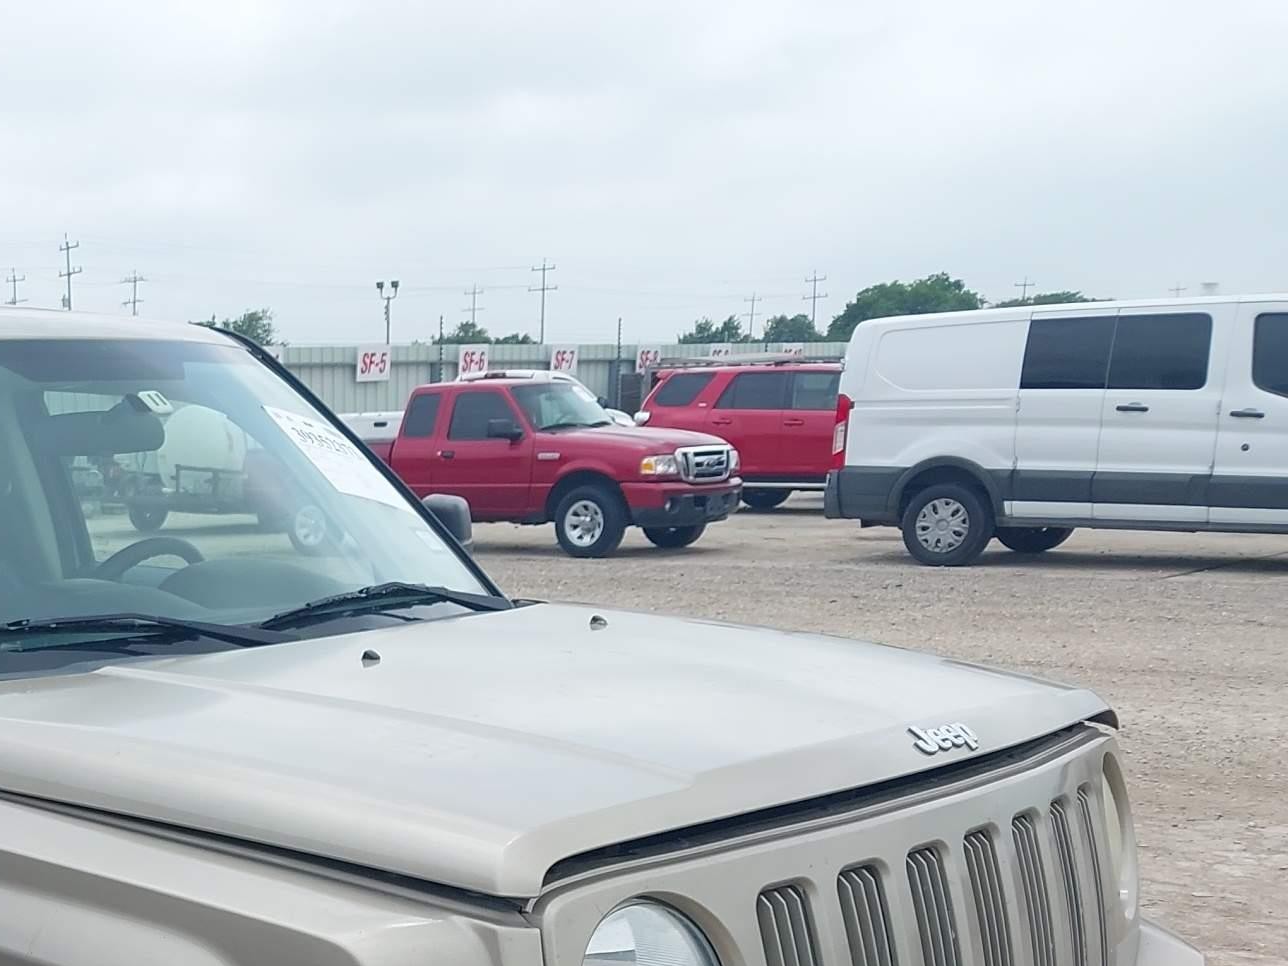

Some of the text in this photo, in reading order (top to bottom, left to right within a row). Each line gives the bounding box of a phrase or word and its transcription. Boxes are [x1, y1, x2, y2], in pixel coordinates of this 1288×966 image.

[361, 352, 388, 374] SF-5
[462, 351, 486, 372] SF-6
[554, 350, 576, 370] SF-7
[905, 723, 980, 756] Jeep
